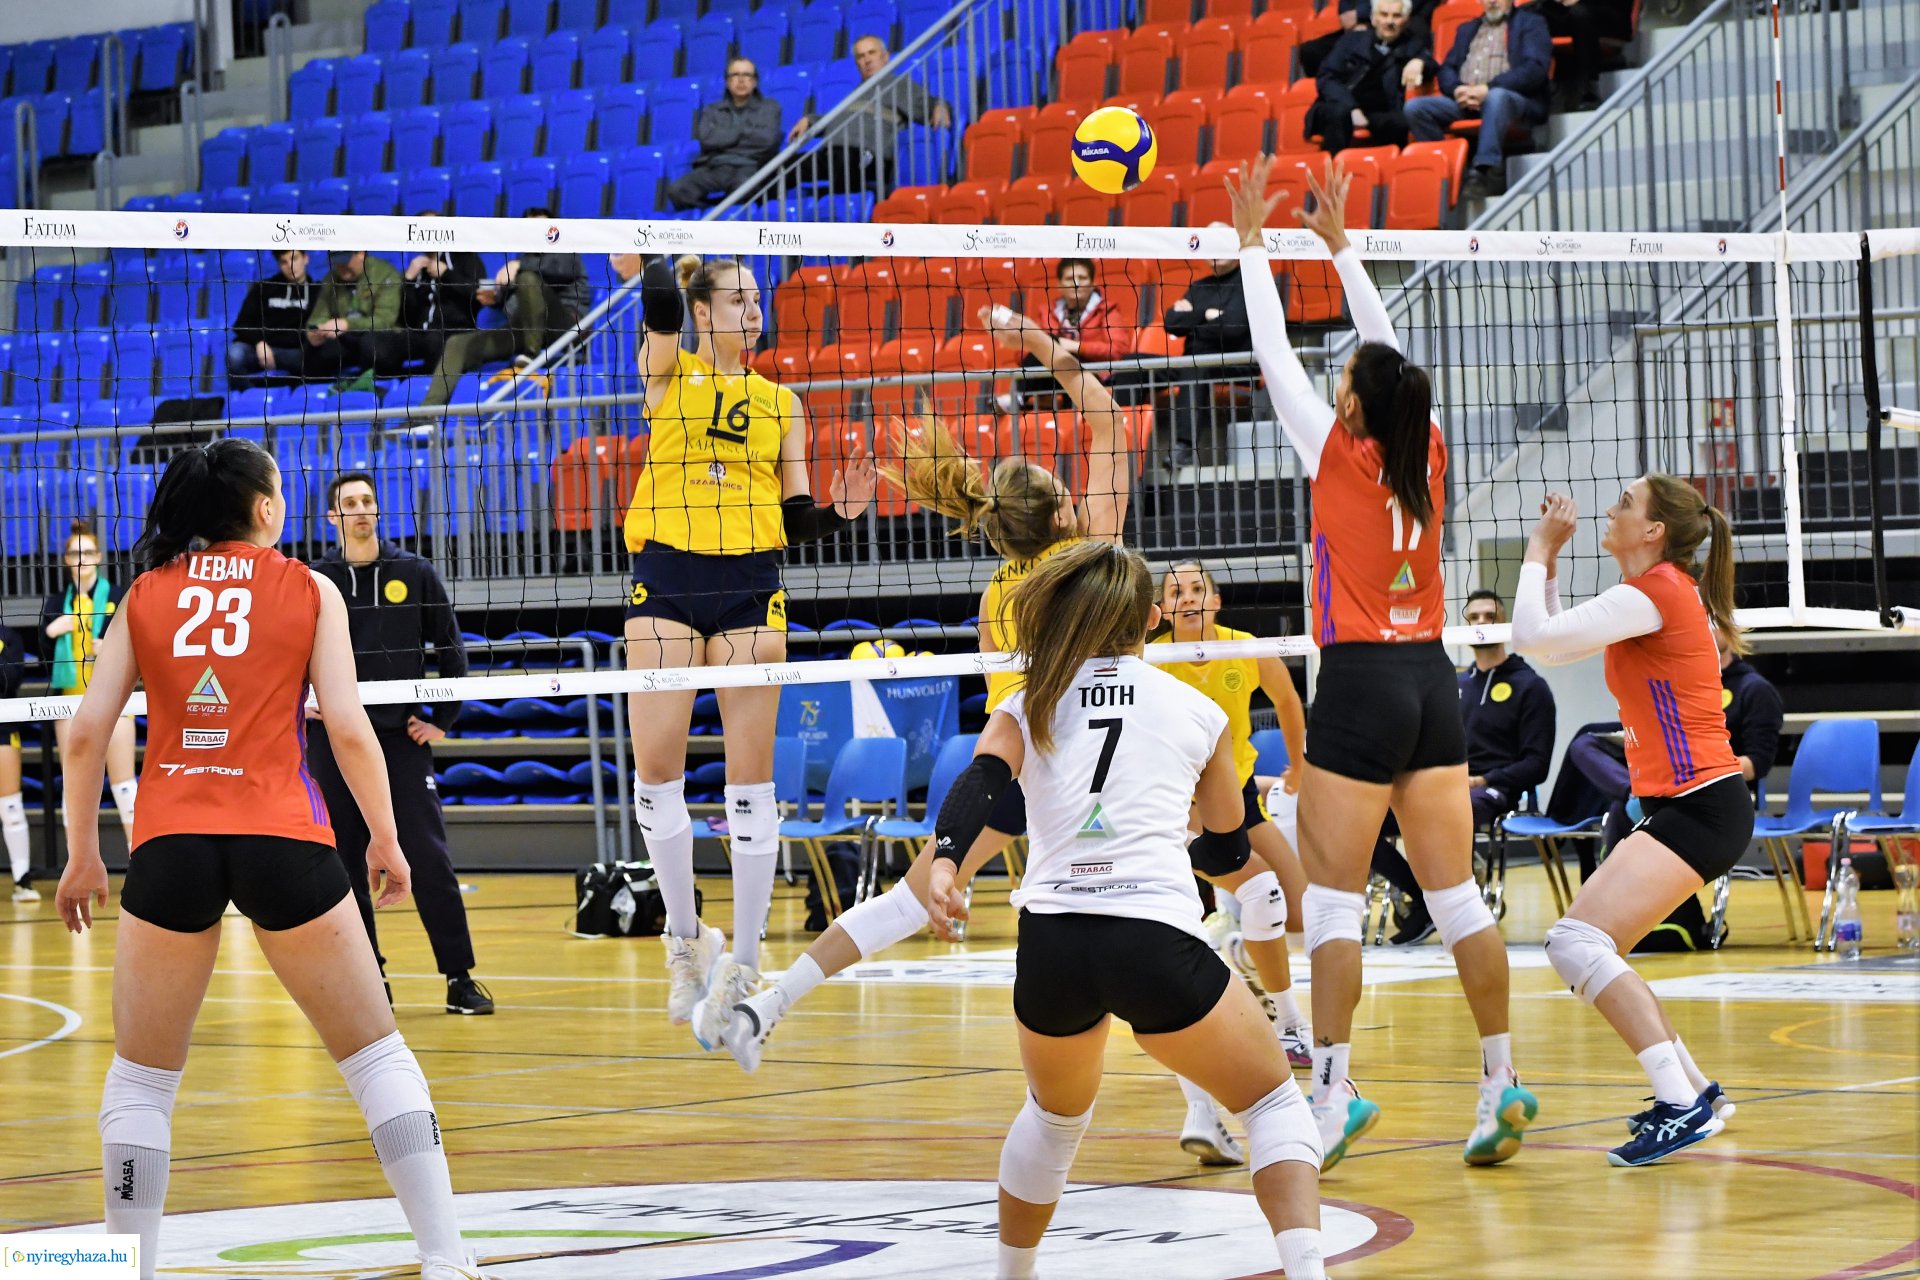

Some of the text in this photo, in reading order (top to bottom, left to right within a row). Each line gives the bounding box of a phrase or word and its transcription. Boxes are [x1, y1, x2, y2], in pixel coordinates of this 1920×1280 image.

[1081, 147, 1109, 156] MIKASA
[23, 216, 76, 236] FATUM
[407, 223, 455, 242] FATUM
[758, 228, 802, 245] FATUM
[1076, 232, 1116, 249] FATUM
[1366, 235, 1402, 252] FATUM
[1630, 238, 1663, 253] FATUM
[711, 391, 751, 432] 16
[188, 555, 254, 582] LEBAN
[172, 585, 253, 658] 23
[414, 684, 454, 699] FATUM
[1078, 683, 1134, 708] TÓTH
[28, 702, 73, 717] FATUM
[185, 734, 225, 743] STRABAG
[1088, 718, 1123, 794] 7
[183, 765, 244, 776] BESTRONG
[1071, 865, 1112, 875] STRABAG
[115, 1159, 135, 1201] MIKASA
